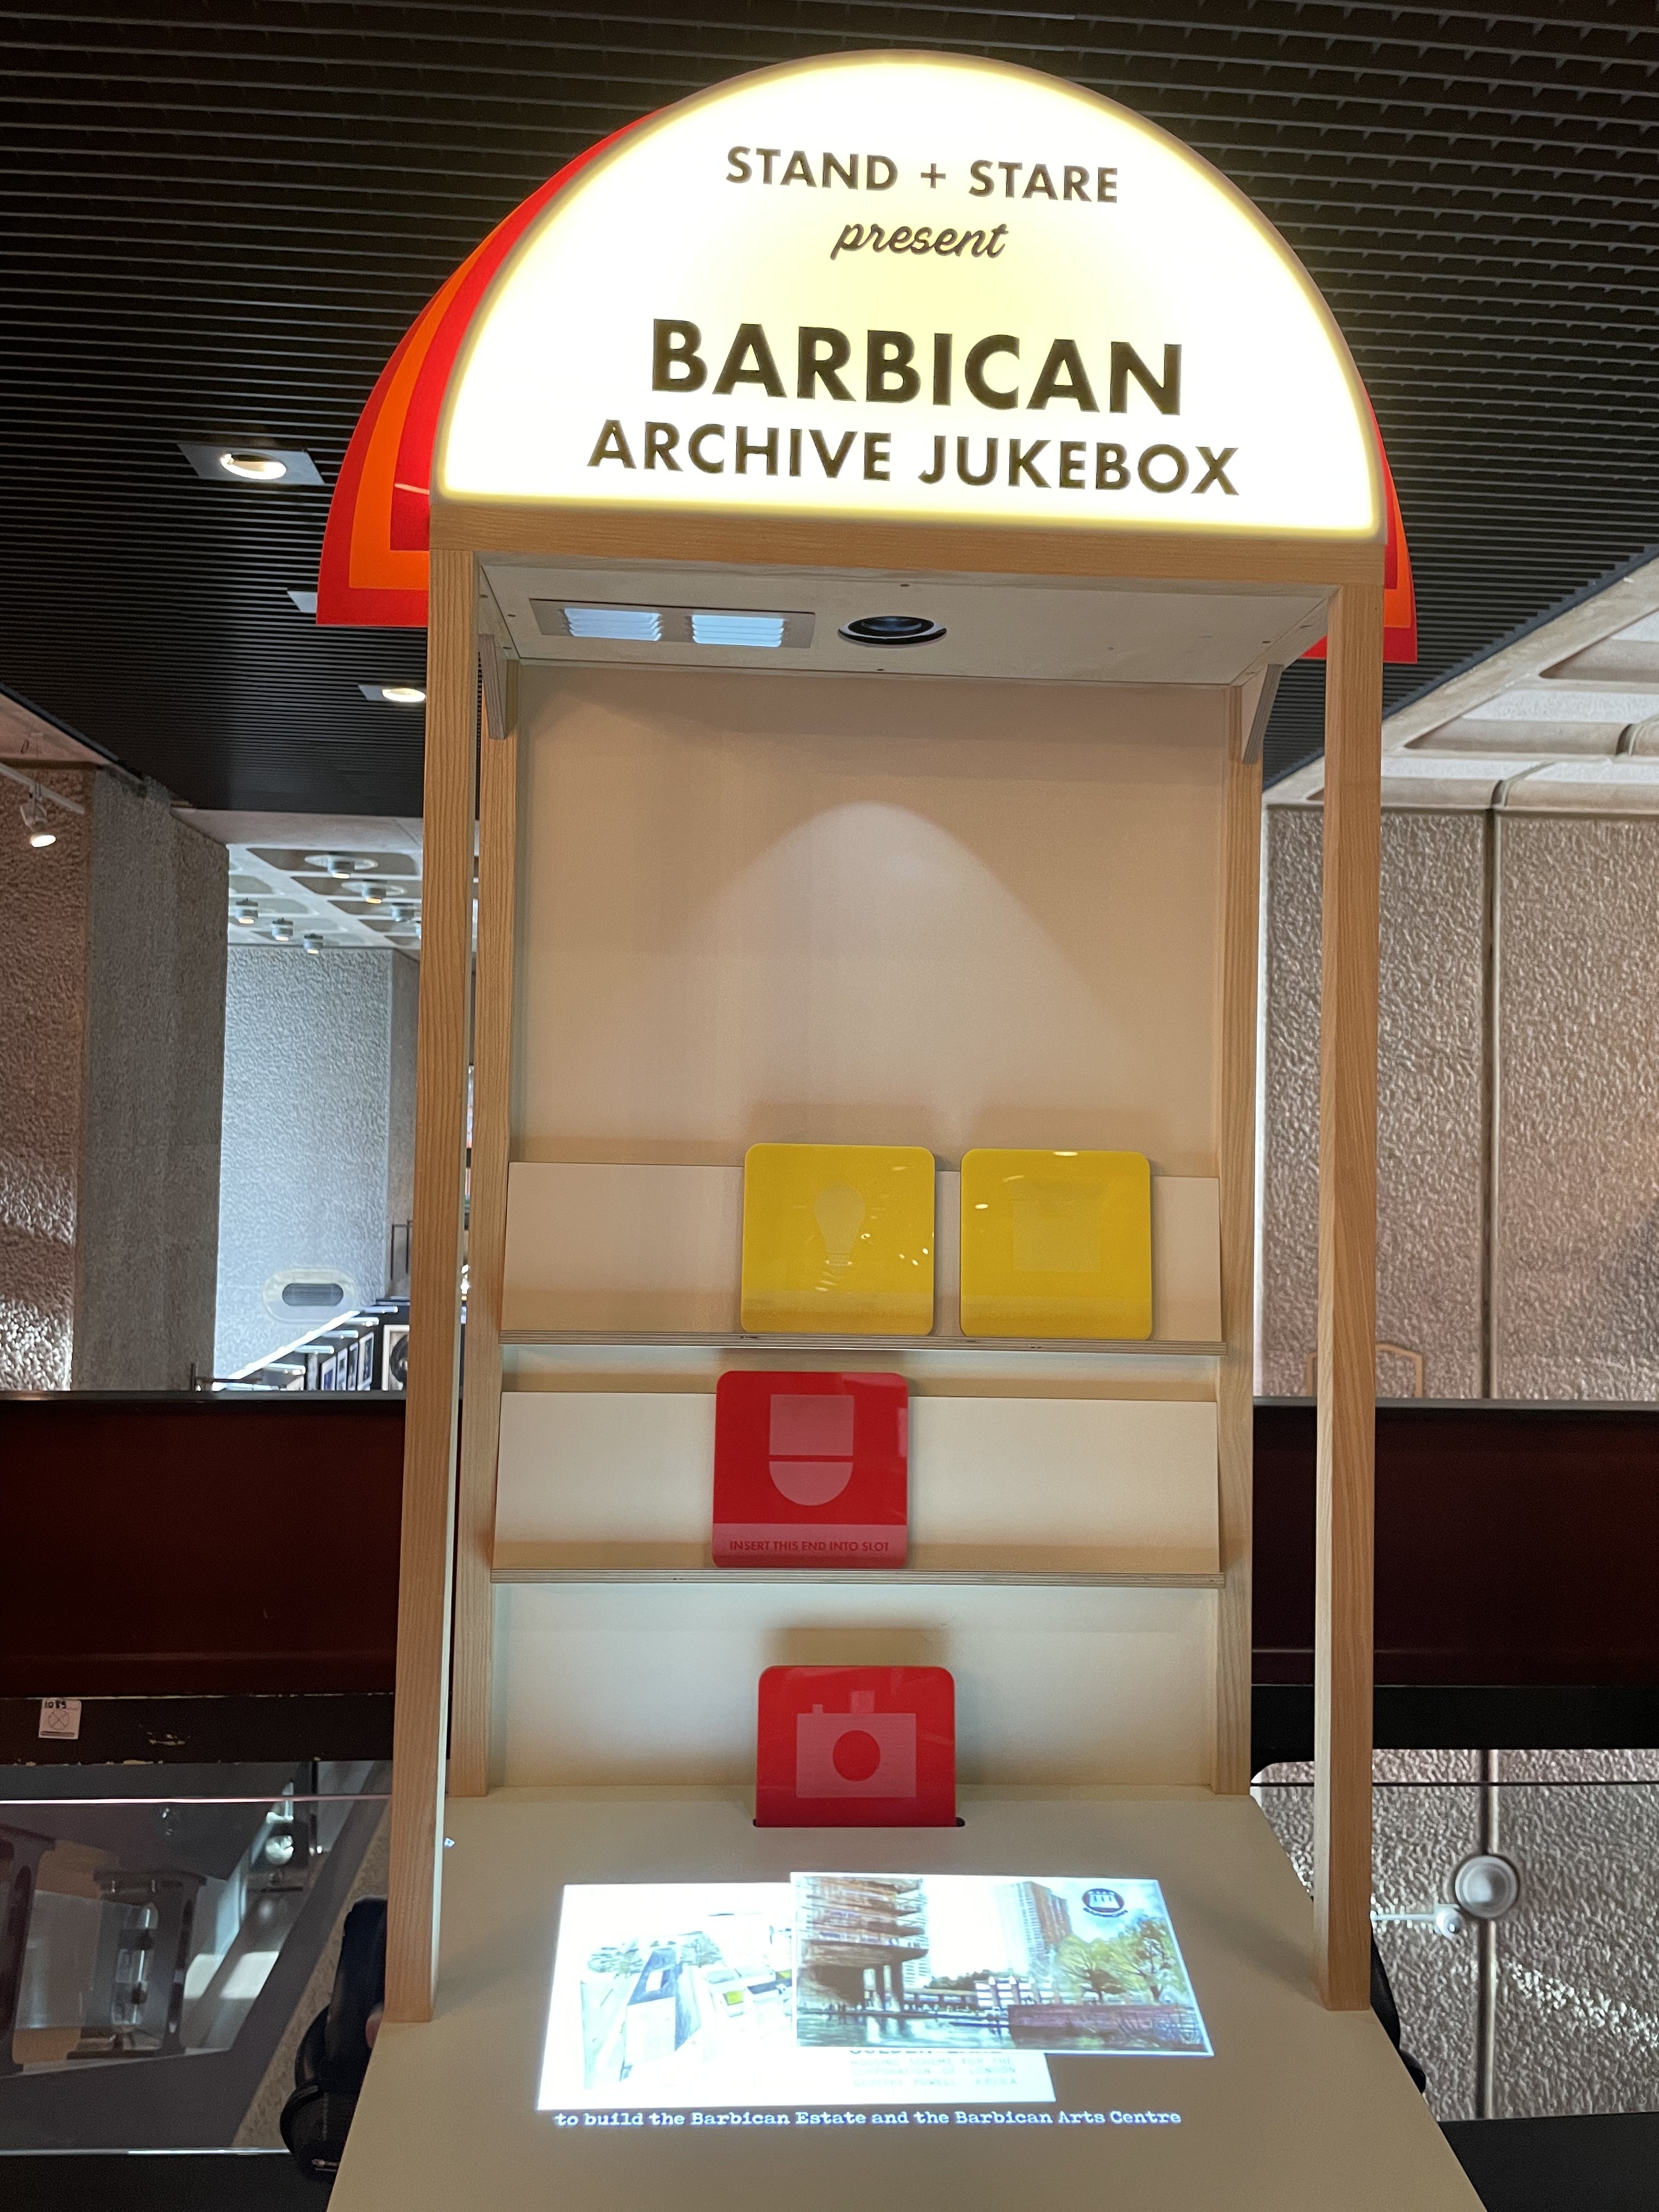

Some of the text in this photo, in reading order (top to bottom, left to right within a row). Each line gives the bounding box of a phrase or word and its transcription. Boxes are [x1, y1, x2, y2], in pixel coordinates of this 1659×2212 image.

[726, 146, 1117, 202] STAND + STARE
[830, 223, 1009, 259] present
[652, 319, 1182, 415] BARBICAN
[588, 420, 1237, 495] ARCHIVE JUKEBOX
[730, 1541, 889, 1551] INSERT THIS END INTO SLOT
[555, 2111, 1182, 2125] to build the Barbican Estate and the Barbican Arts Centre
